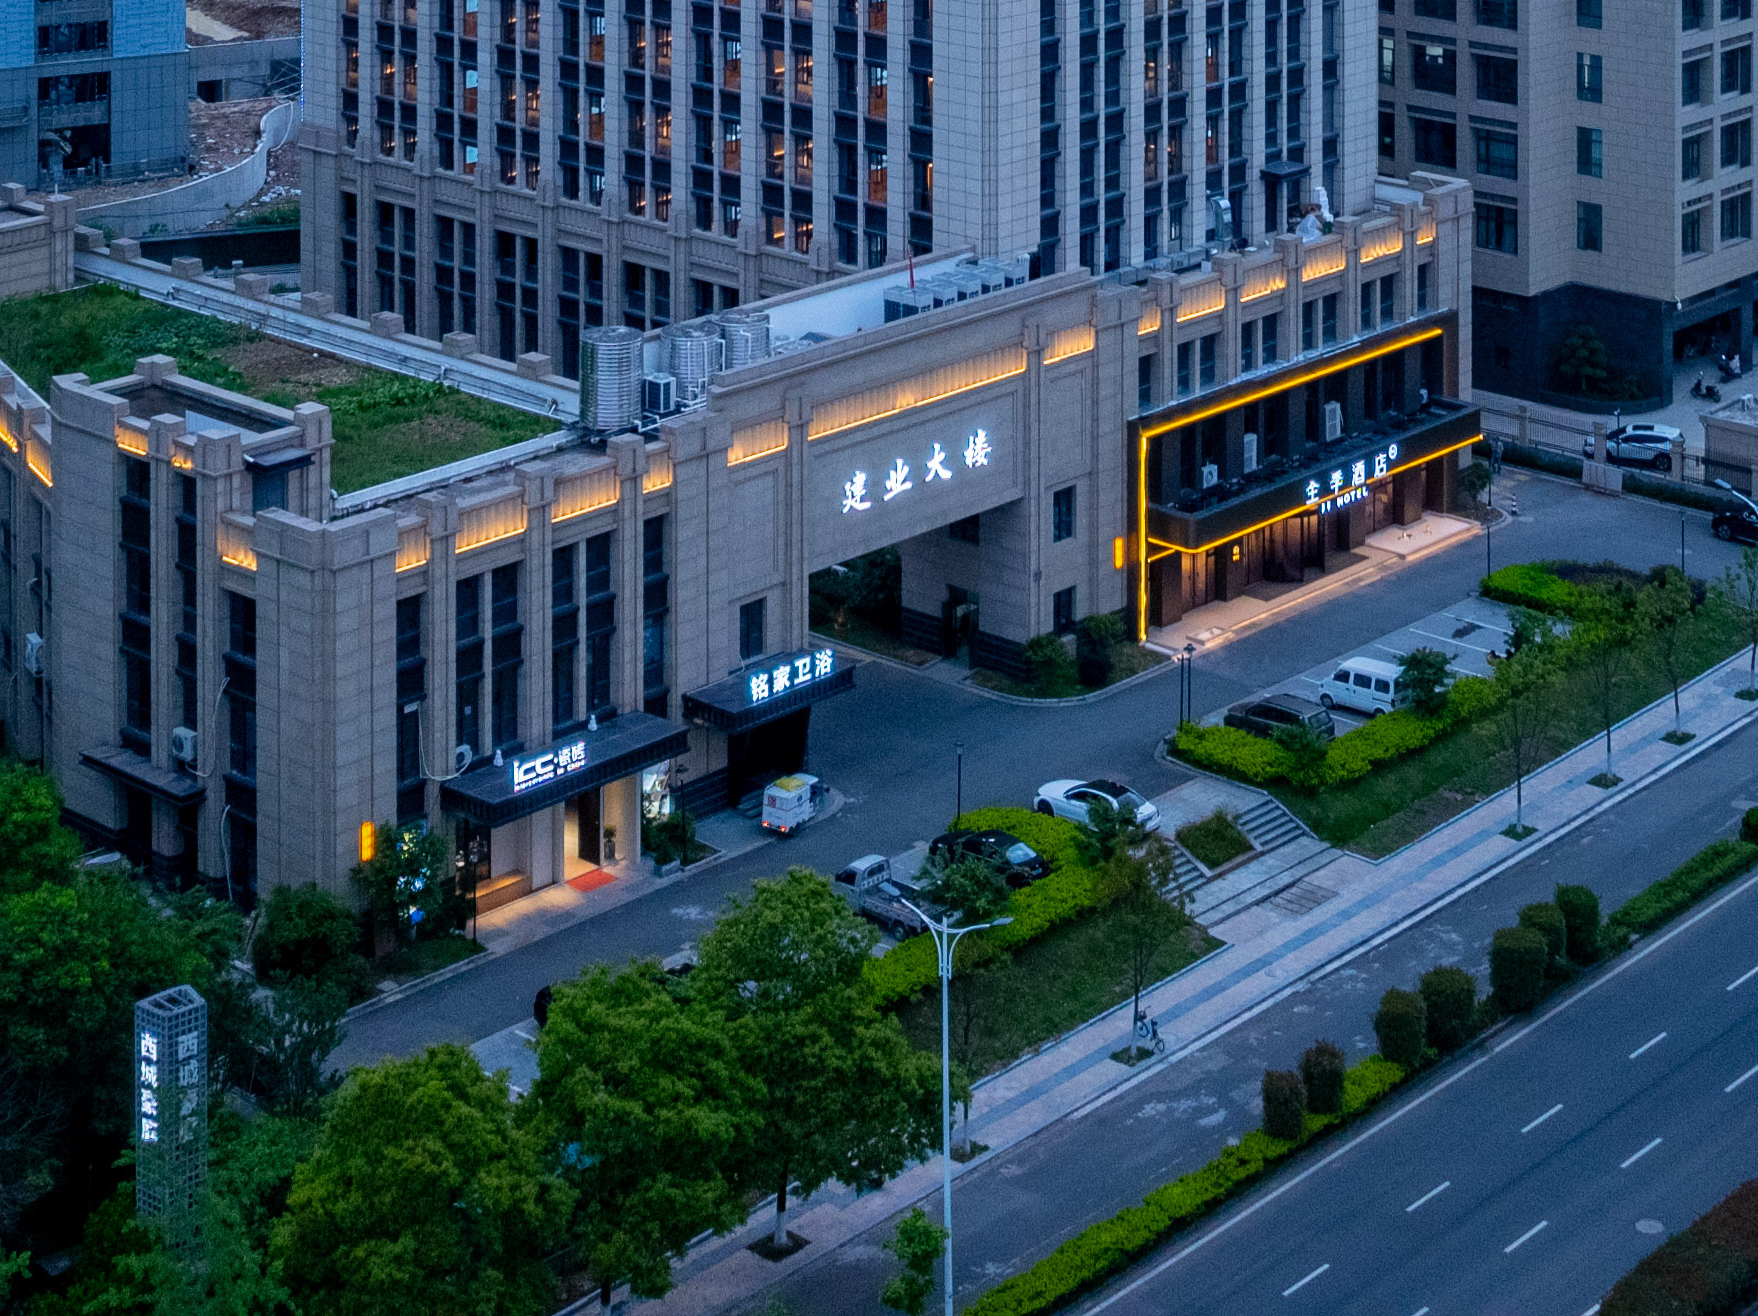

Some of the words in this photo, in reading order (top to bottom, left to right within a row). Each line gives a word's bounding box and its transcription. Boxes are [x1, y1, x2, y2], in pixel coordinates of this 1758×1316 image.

[842, 428, 993, 514] 建业大楼
[1305, 452, 1388, 506] 全季酒店
[1336, 485, 1369, 508] HOTEL
[750, 649, 834, 703] 铭家卫浴
